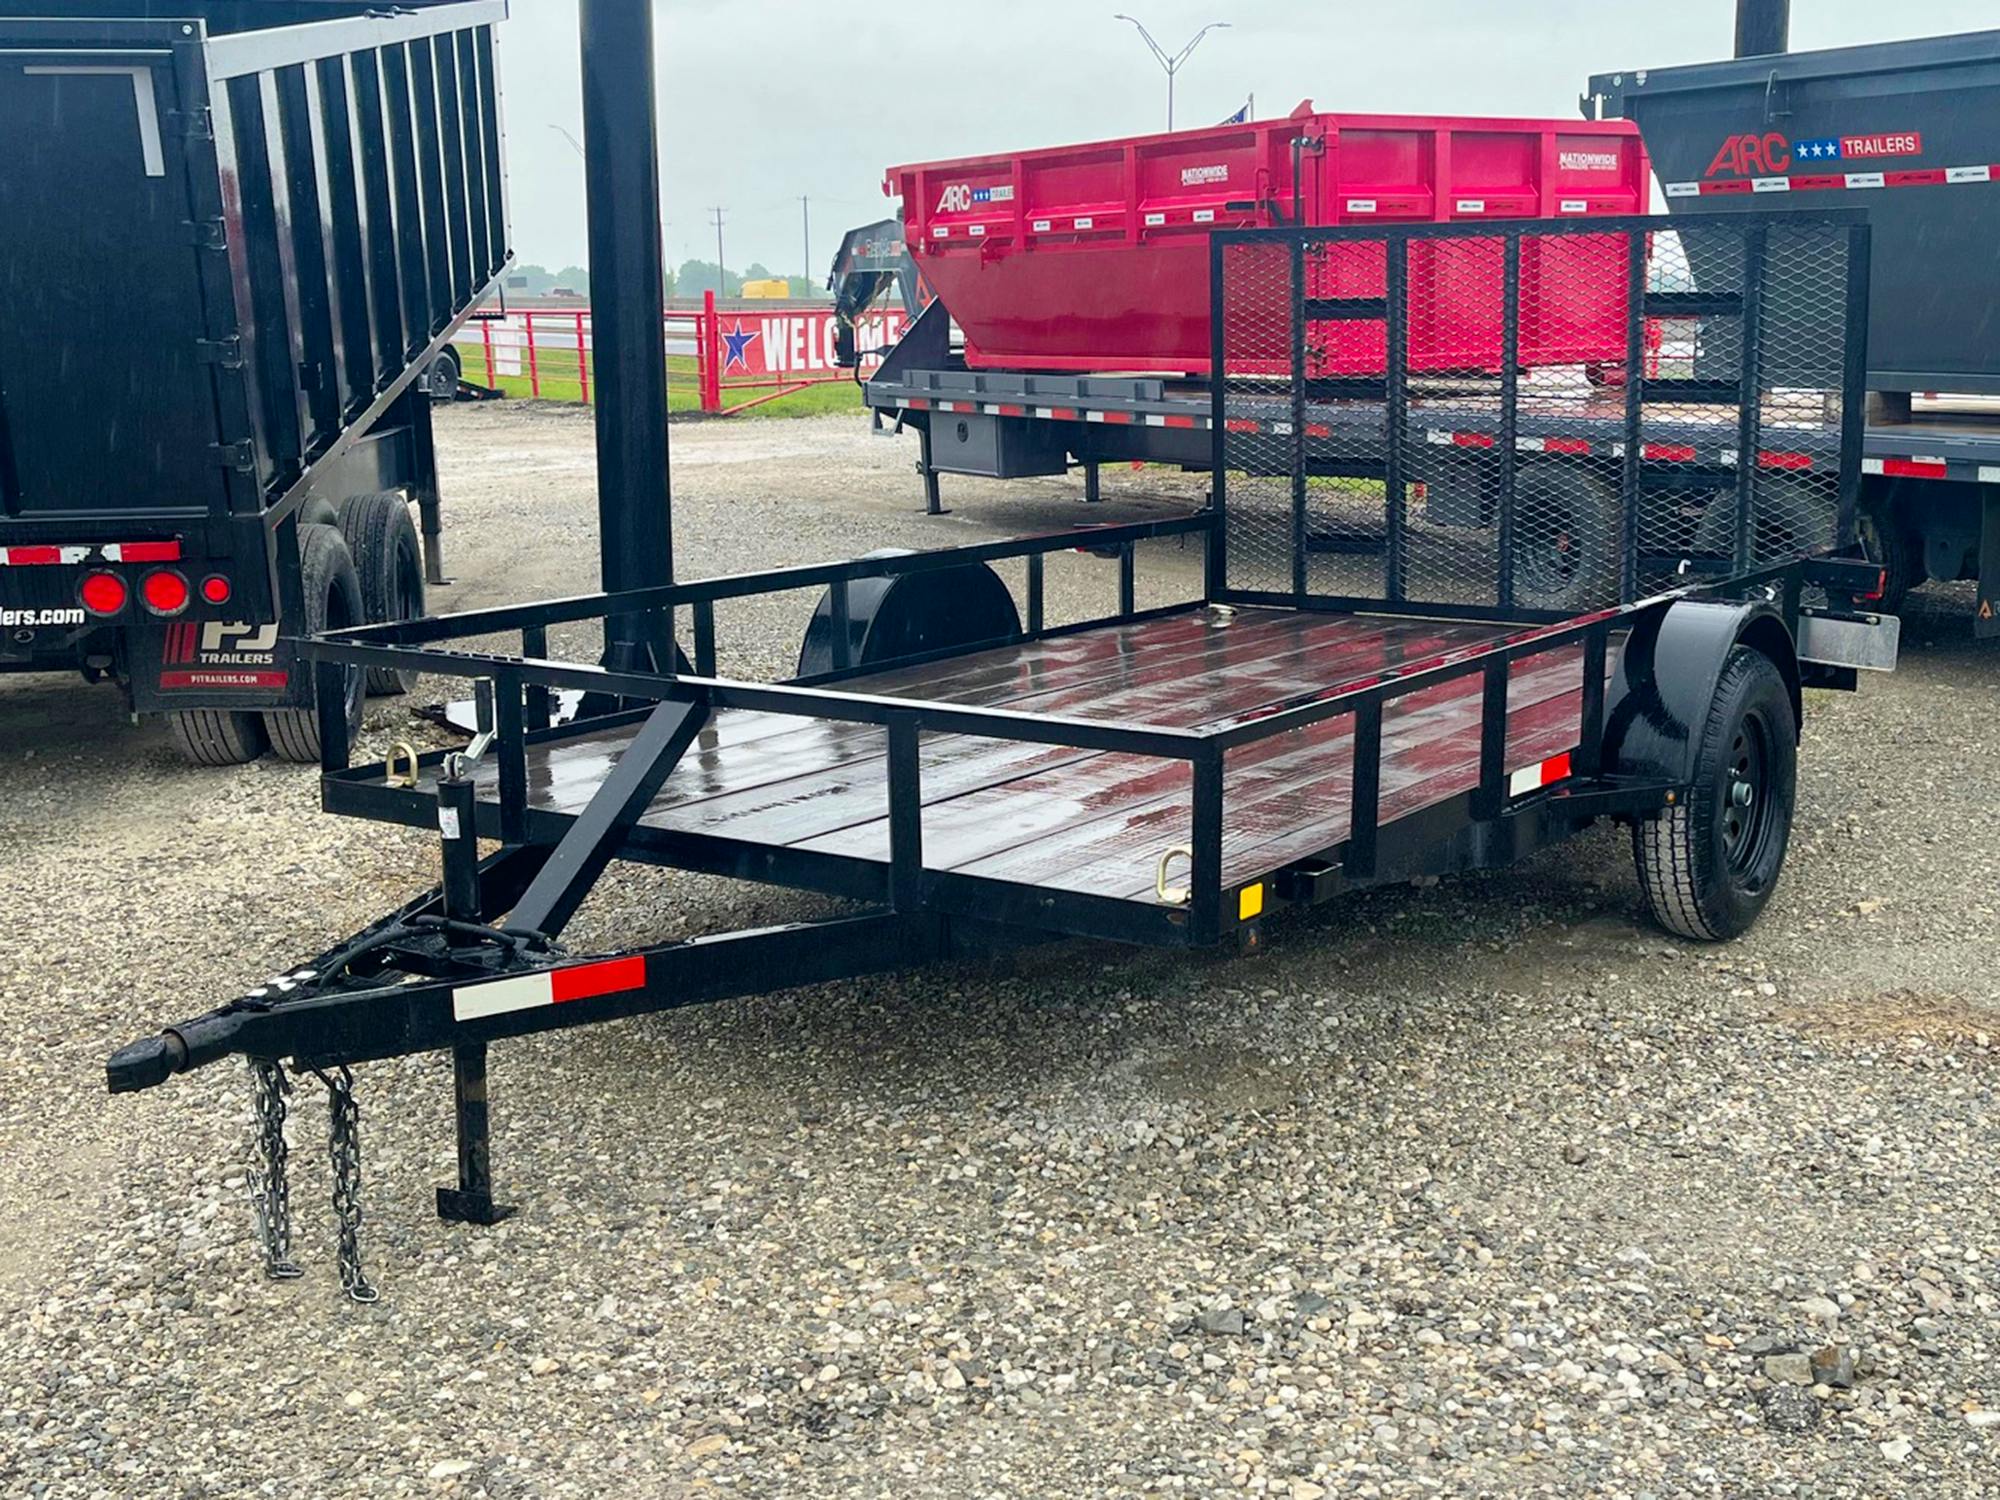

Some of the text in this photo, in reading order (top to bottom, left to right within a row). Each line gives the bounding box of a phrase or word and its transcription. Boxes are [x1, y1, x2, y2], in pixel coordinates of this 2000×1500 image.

[1560, 152, 1617, 166] NATIONWIDE
[1704, 132, 1915, 176] ARC TRAILERS
[935, 184, 971, 213] ARC
[761, 316, 900, 371] WELCME
[201, 621, 279, 650] PJ
[200, 653, 274, 664] TRAILERS
